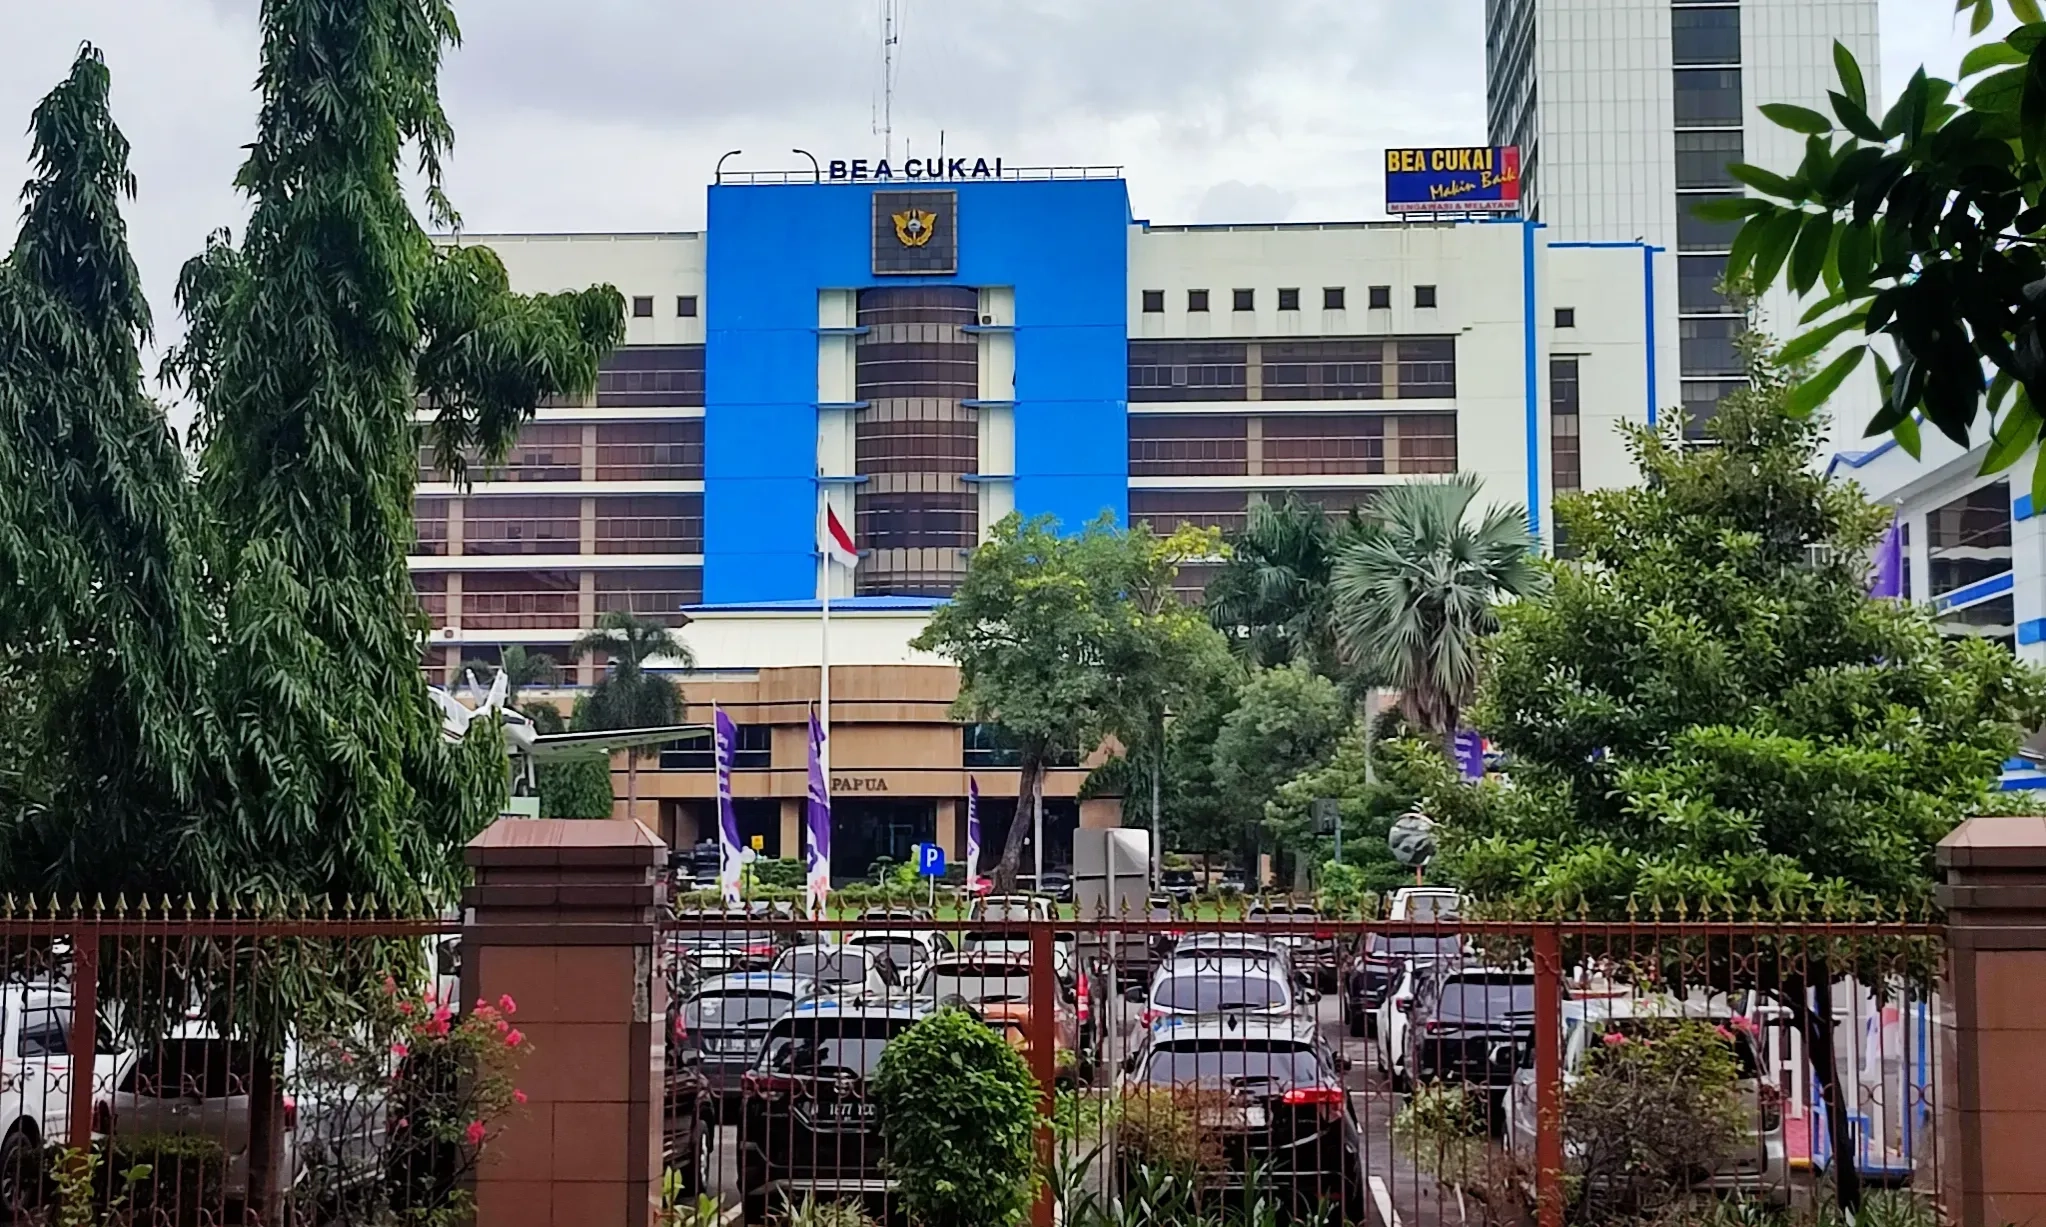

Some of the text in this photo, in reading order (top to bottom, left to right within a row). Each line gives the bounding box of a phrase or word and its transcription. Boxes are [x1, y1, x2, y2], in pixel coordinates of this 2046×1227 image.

[829, 157, 1002, 179] BEA CUKAI
[1387, 149, 1492, 172] BEA CUKAI
[1430, 167, 1516, 200] Makin Baik
[831, 778, 888, 791] PAPUA
[926, 848, 938, 868] P
